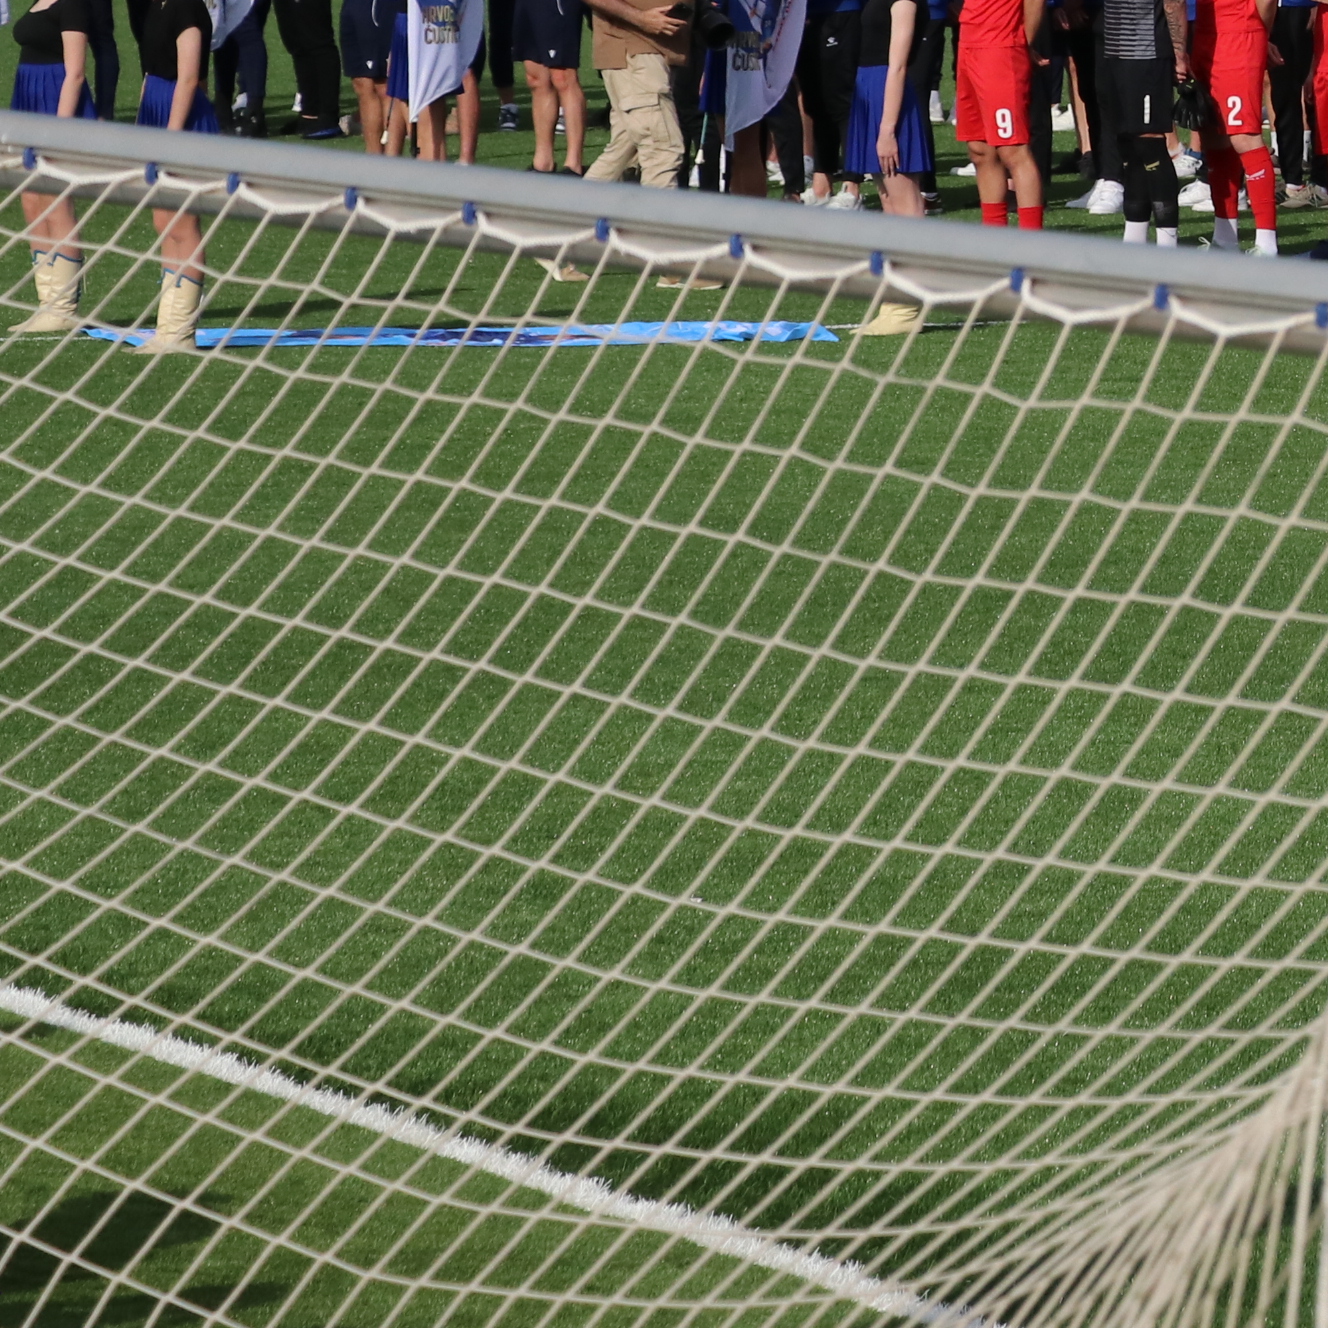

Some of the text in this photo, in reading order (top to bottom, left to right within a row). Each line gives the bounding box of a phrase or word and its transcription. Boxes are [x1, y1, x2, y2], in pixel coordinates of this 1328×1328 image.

[995, 108, 1013, 139] 9
[1143, 94, 1150, 124] 1
[1227, 95, 1243, 126] 2
